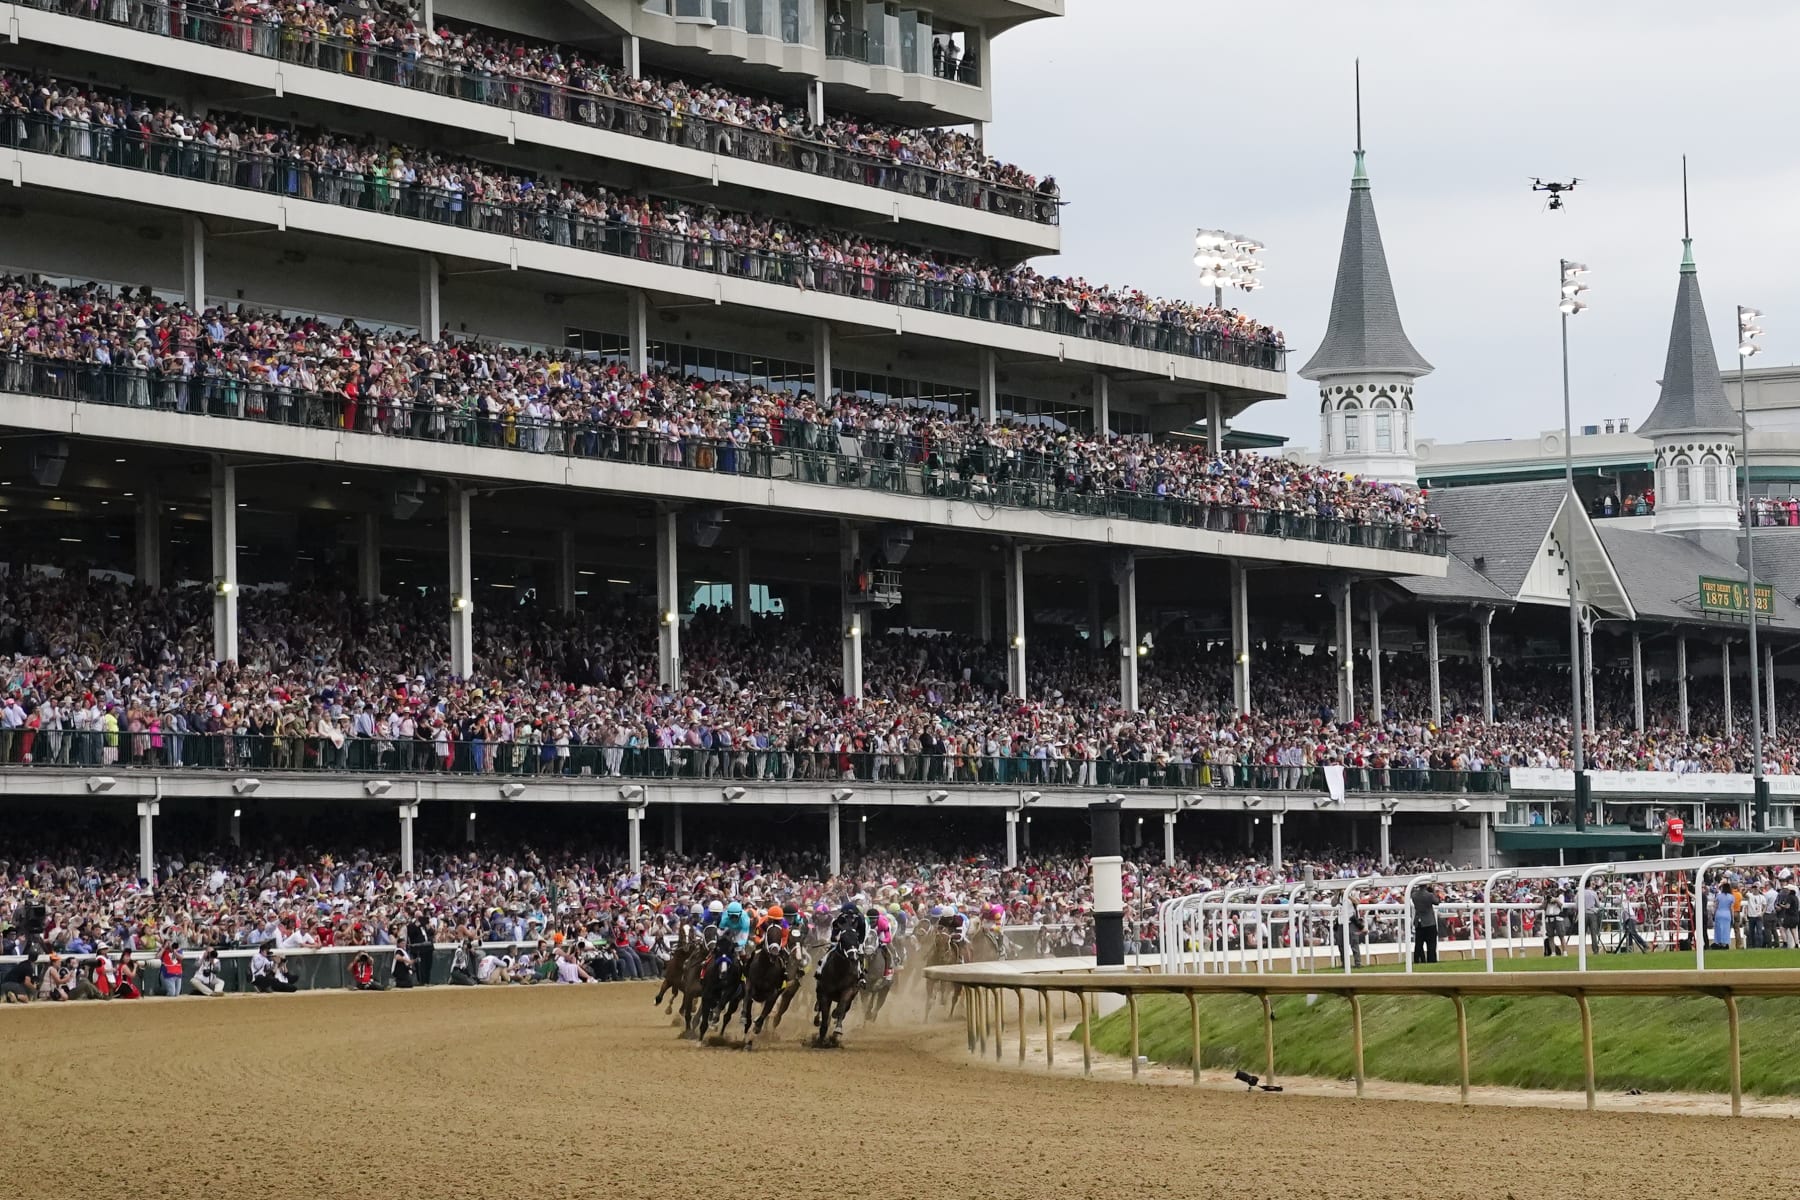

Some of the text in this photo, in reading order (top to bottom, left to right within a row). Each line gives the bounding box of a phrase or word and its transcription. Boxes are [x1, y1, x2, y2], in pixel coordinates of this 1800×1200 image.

[1702, 582, 1716, 591] FIRST
[1716, 583, 1731, 593] DERBY
[1706, 592, 1729, 606] 1875
